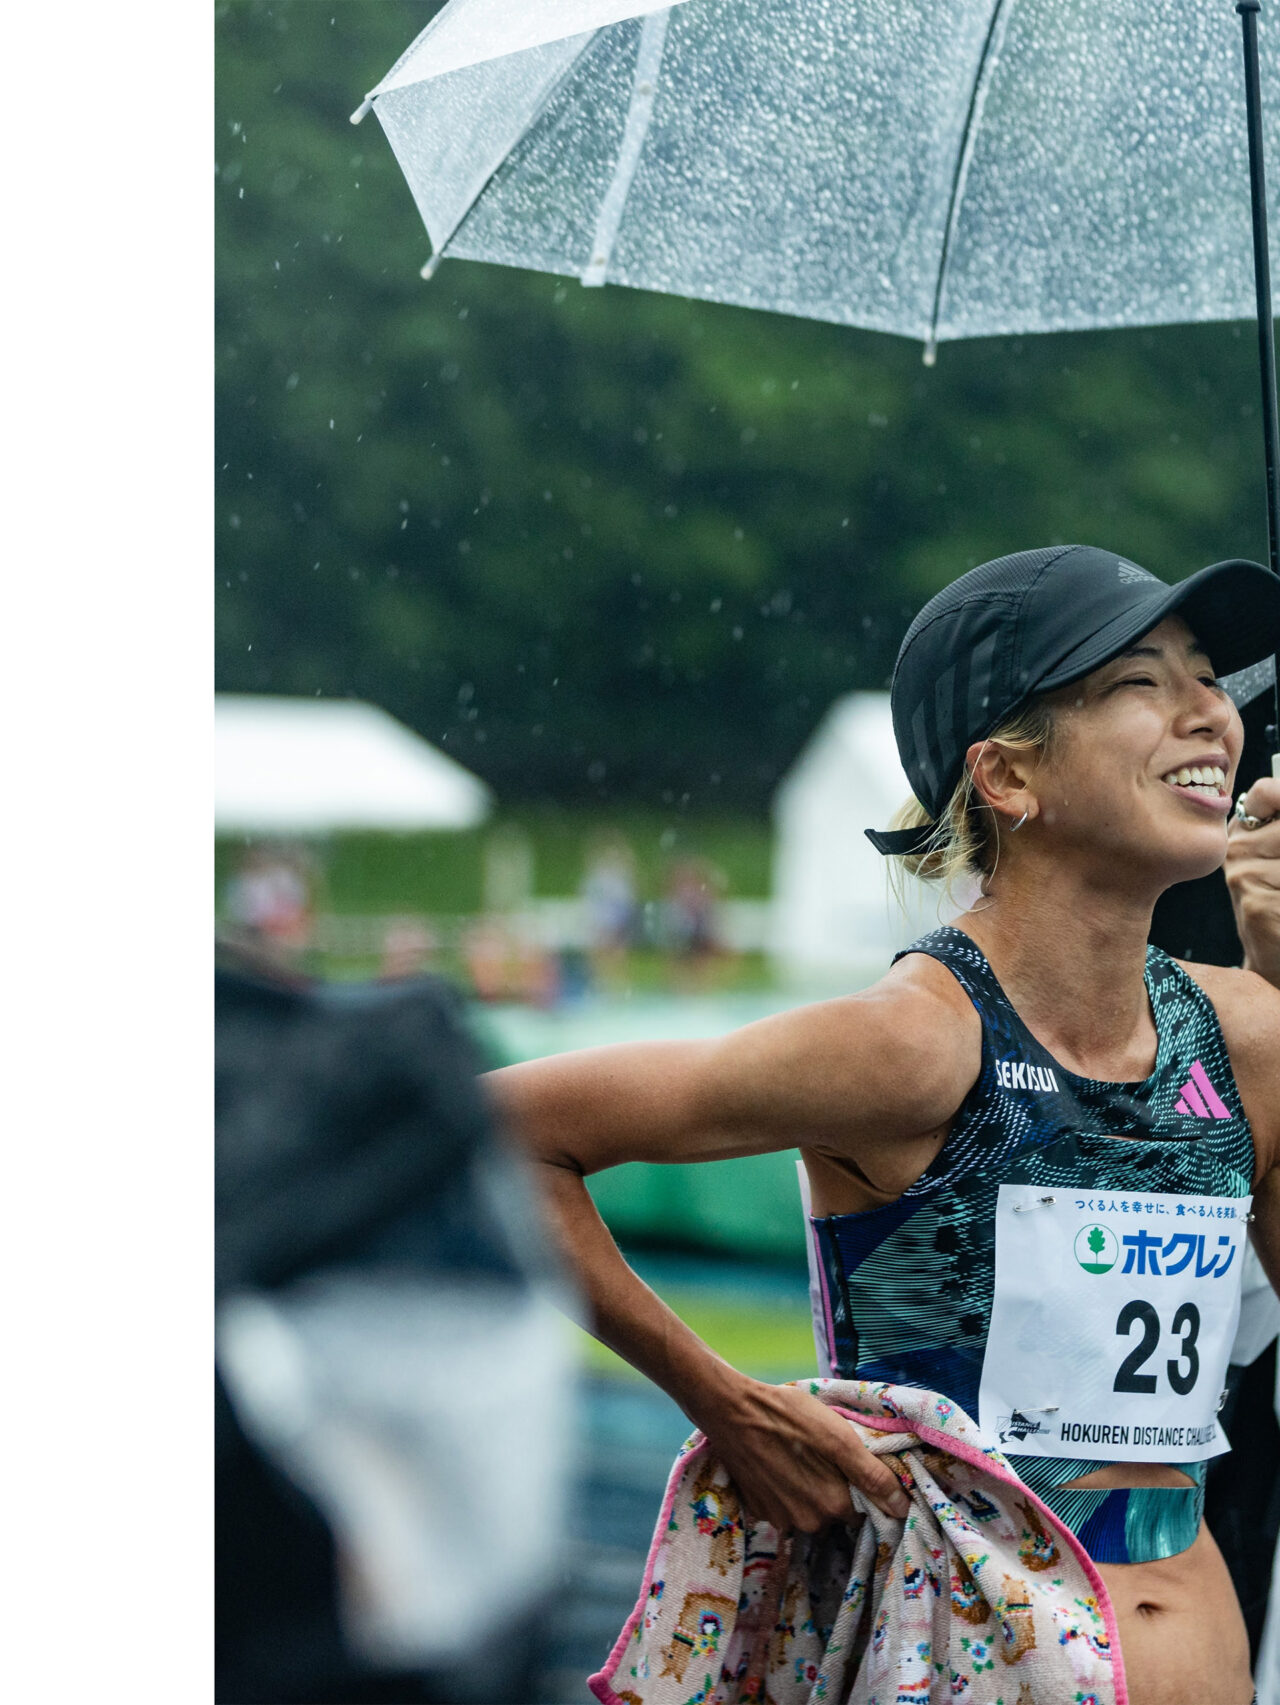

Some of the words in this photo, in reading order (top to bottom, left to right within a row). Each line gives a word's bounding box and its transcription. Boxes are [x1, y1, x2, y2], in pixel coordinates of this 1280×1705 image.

[995, 1059, 1060, 1093] SEKISUI
[1121, 1229, 1236, 1279] ホクレン
[1112, 1299, 1201, 1396] 23
[1060, 1422, 1129, 1445] HOKUREN
[1133, 1426, 1185, 1446] DISTANCE
